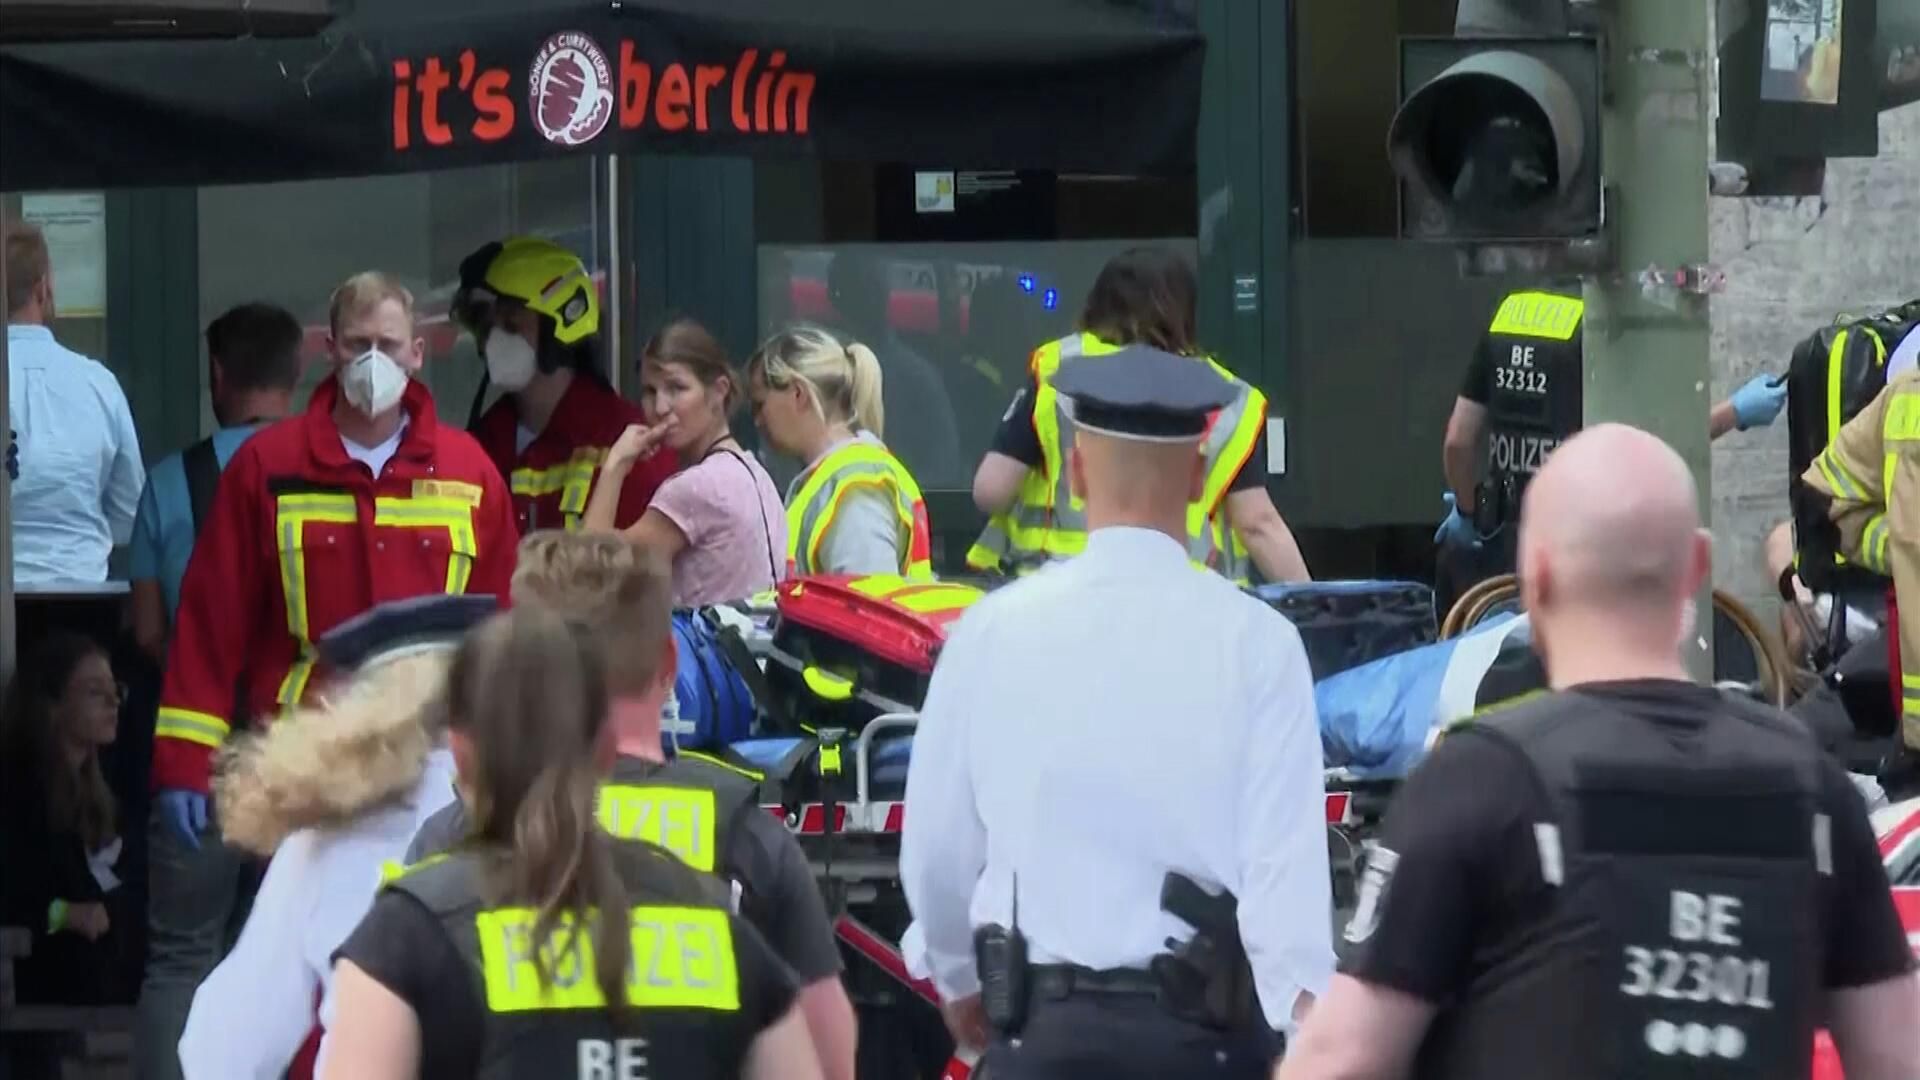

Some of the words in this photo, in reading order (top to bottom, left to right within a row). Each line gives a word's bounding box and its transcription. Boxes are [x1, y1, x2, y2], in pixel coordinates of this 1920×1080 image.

[393, 48, 515, 149] it's
[618, 38, 817, 132] berlin
[1502, 297, 1577, 332] POLIZEI
[1511, 345, 1535, 368] BE
[1496, 367, 1548, 394] 32312
[1489, 431, 1562, 474] POLIZE
[1669, 889, 1743, 946] BE
[1618, 944, 1776, 1010] 32301
[576, 1037, 650, 1080] BE
